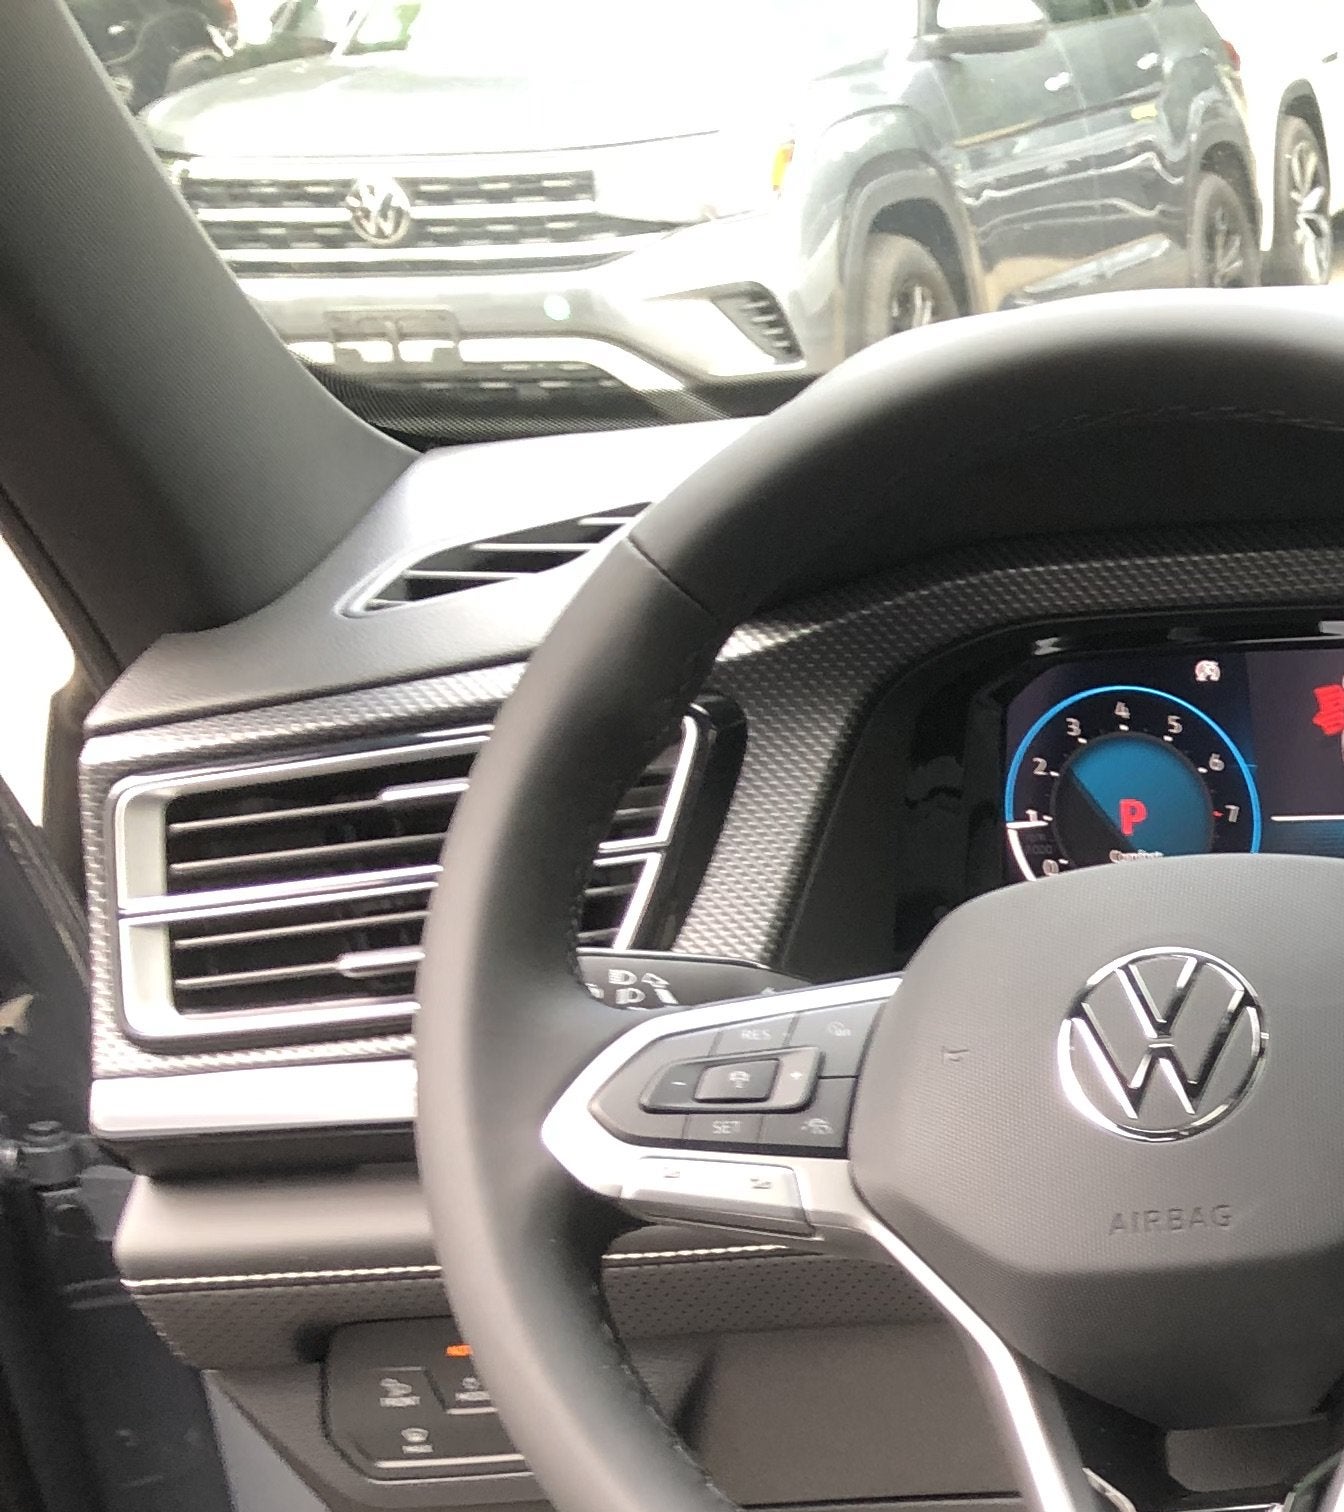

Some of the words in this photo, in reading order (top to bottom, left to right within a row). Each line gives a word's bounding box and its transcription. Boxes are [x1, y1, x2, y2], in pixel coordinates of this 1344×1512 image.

[1114, 701, 1131, 720] 4
[1065, 716, 1082, 737] 3
[1167, 714, 1183, 734] 5
[1032, 757, 1048, 776] 2
[1208, 753, 1225, 772] 6
[1119, 798, 1147, 836] P
[1225, 804, 1241, 823] 7
[740, 1027, 773, 1042] RES
[711, 1119, 743, 1136] SET
[1108, 1203, 1235, 1238] AIRBAG
